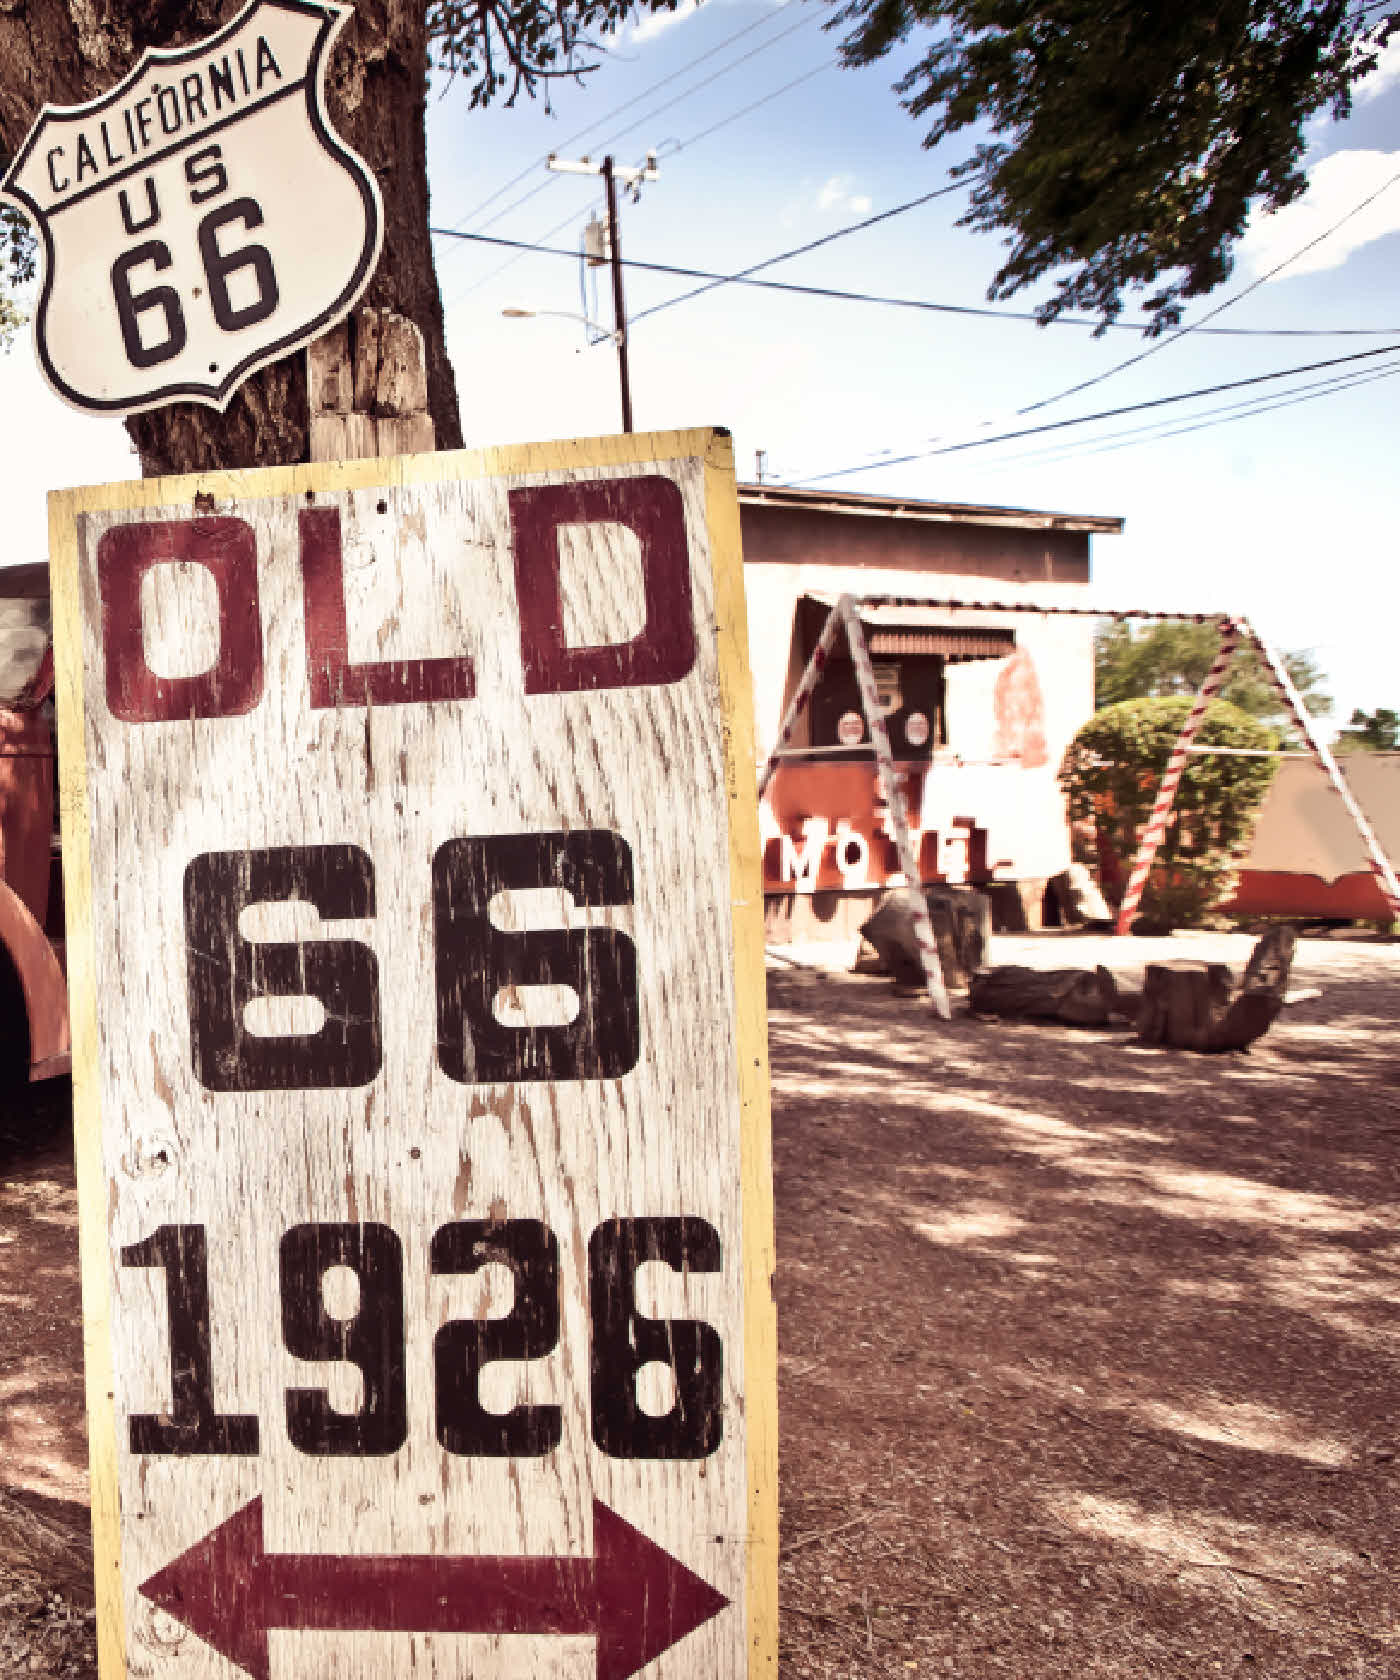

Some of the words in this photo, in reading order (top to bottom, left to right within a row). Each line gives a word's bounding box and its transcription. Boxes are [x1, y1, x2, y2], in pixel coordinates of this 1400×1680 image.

[46, 35, 283, 193] CALIFORNIA
[111, 197, 279, 369] 66
[97, 475, 696, 723] OLD
[183, 830, 639, 1092] 66
[121, 1217, 724, 1460] 1926
